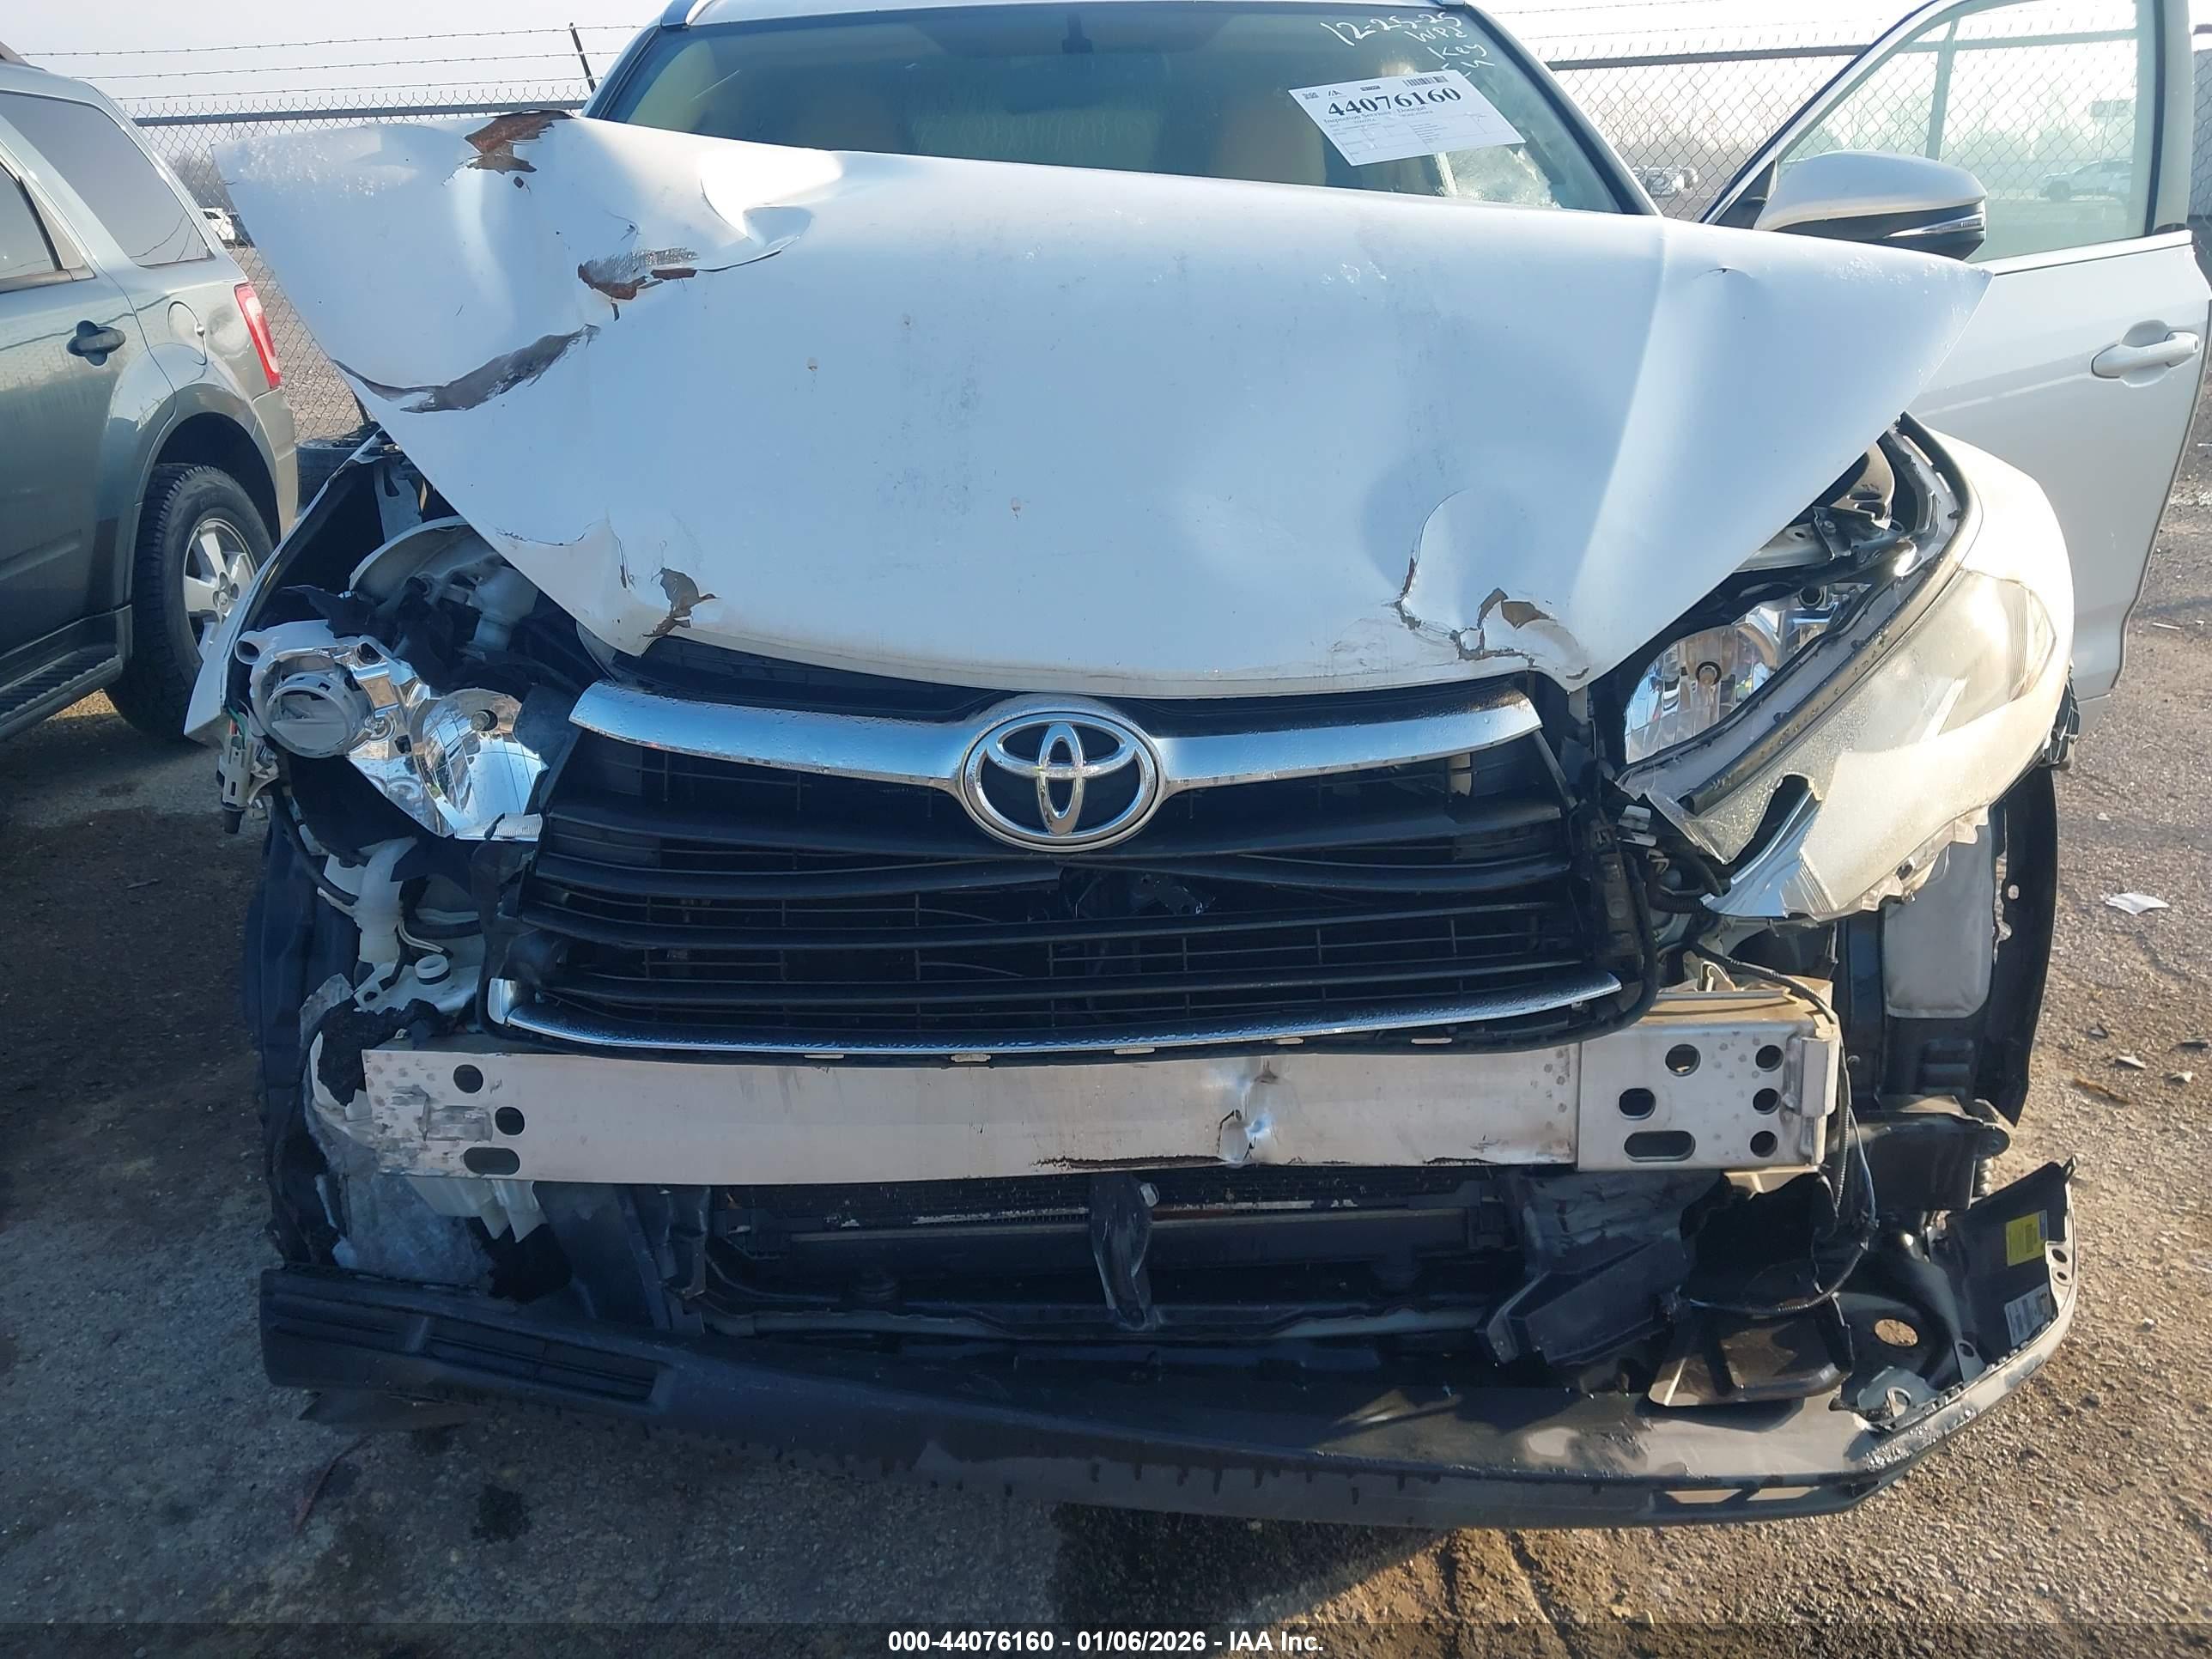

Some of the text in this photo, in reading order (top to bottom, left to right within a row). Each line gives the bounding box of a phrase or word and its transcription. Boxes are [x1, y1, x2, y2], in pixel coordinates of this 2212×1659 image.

[1320, 11, 1462, 46] 12-25-25
[1427, 43, 1487, 61] Key
[1328, 87, 1462, 117] 44076160
